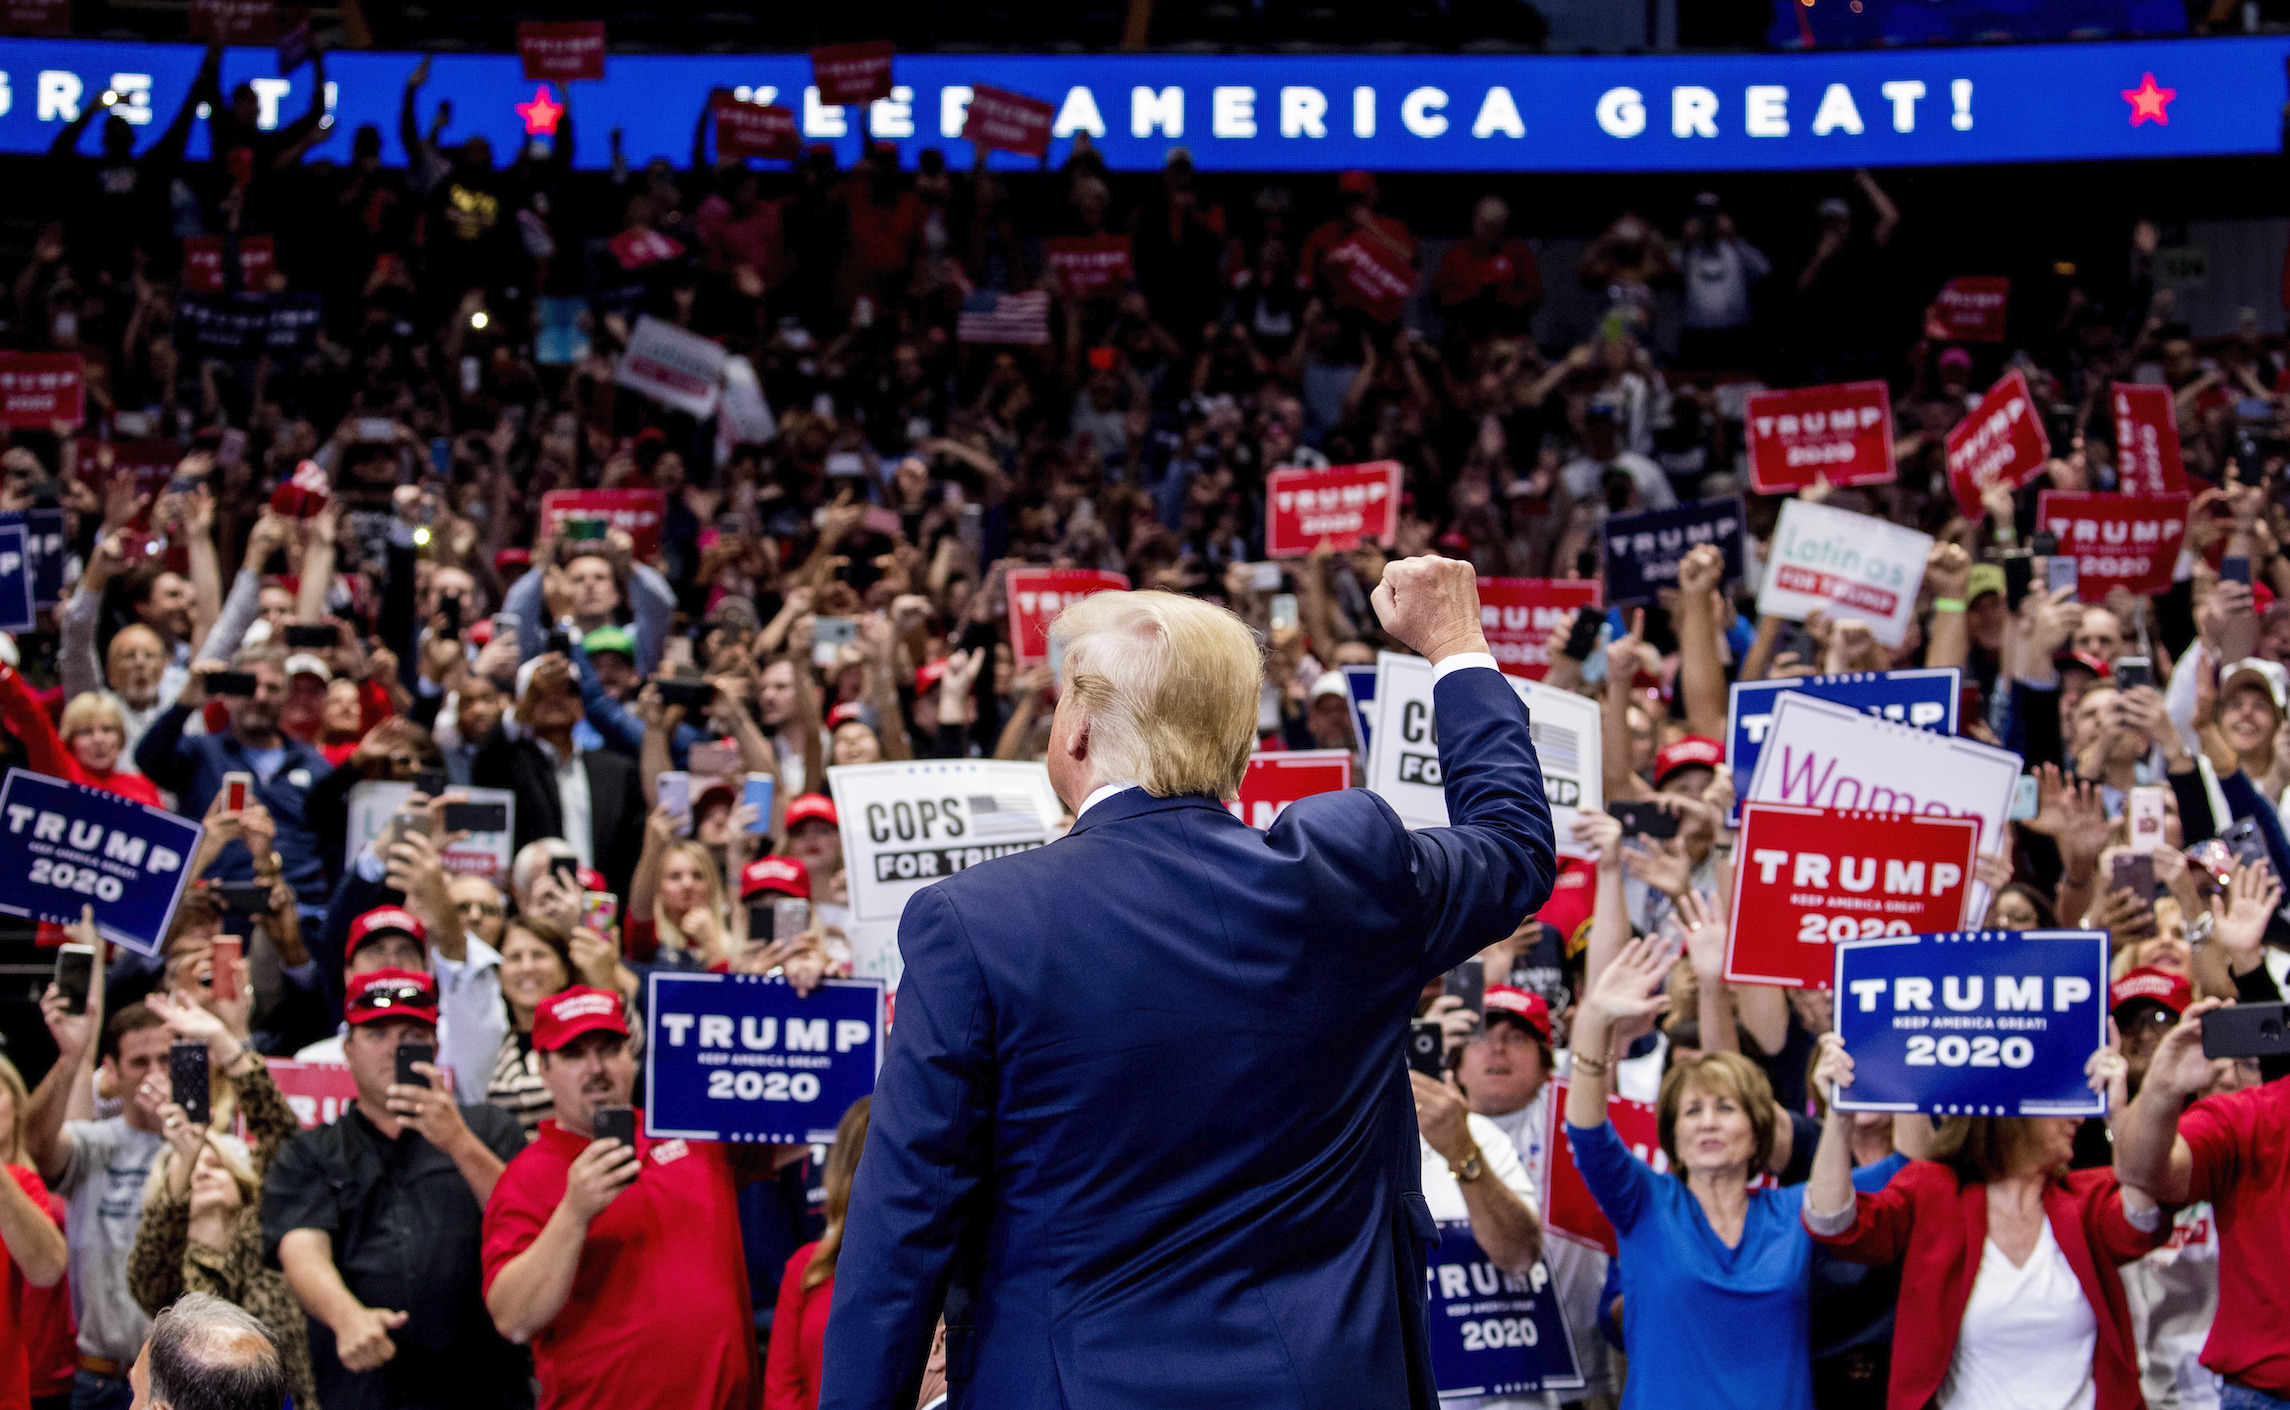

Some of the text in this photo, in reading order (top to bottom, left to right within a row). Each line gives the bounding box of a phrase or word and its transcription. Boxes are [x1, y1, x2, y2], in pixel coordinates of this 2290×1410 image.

[1053, 86, 1525, 138] AMERICA
[1596, 79, 1973, 138] GREAT!
[1756, 405, 1880, 439] TRUMP
[1278, 481, 1387, 514] TRUMP
[1610, 517, 1738, 557] TRUMP
[2048, 517, 2183, 544] TRUMP
[1402, 758, 1443, 786] FO
[867, 798, 964, 843] COPS
[7, 803, 181, 874] TRUMP
[28, 857, 124, 902] 2020
[877, 852, 939, 881] FOR
[1753, 848, 1961, 896] TRUMP
[1790, 893, 1825, 906] KEEP
[1826, 895, 1882, 911] AMERICA
[1850, 975, 2091, 1013] TRUMP
[661, 1013, 870, 1053] TRUMP
[1892, 1016, 2047, 1031] KEEP AMERICA GREAT!
[730, 1053, 785, 1068] AMERICA
[1905, 1035, 2034, 1069] 2020
[707, 1070, 820, 1103] 2020
[1461, 1317, 1539, 1351] 2020
